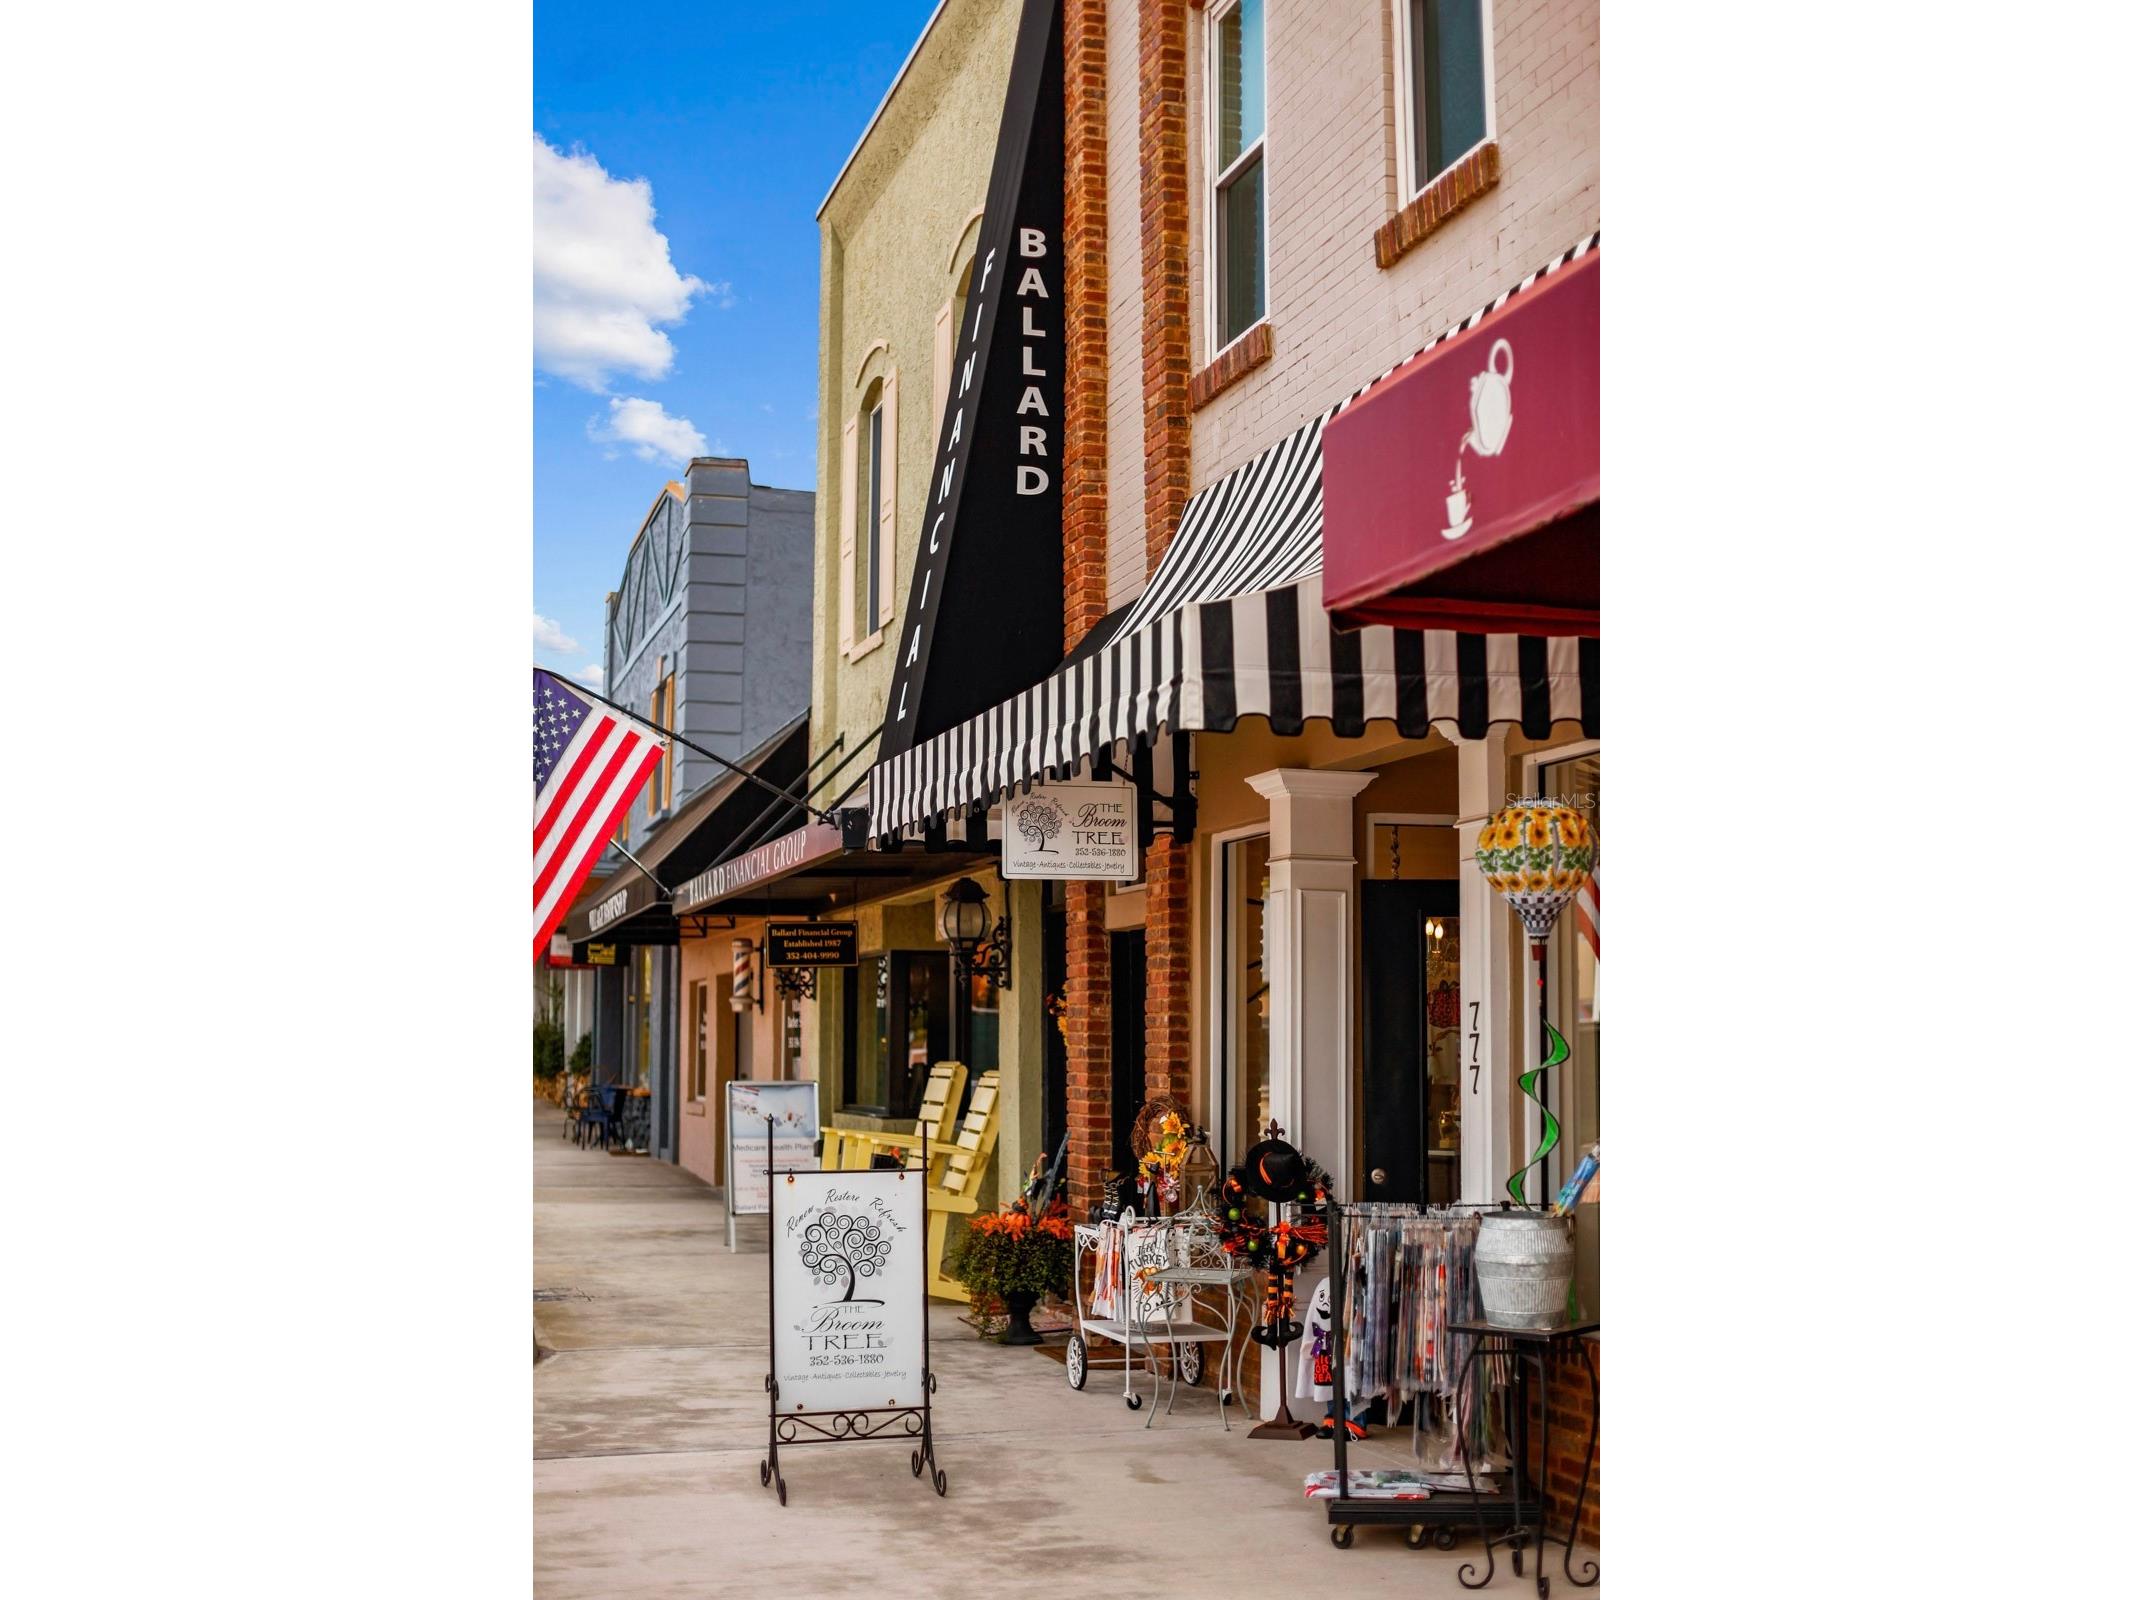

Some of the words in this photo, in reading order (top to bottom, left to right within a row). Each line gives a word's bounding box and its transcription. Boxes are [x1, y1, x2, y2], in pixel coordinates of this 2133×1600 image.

[1016, 228, 1049, 496] BALLARD
[897, 248, 996, 722] FINANCIAL
[1072, 803, 1127, 828] Broom
[1101, 803, 1125, 813] THE
[1071, 831, 1126, 846] TREE
[1075, 847, 1126, 857] 352-536-1880
[689, 868, 724, 905] BALLARD
[726, 848, 770, 889] FINANCIAL
[773, 830, 806, 870] GROUP
[1013, 860, 1036, 870] Vintage
[1039, 860, 1066, 870] Antiques
[771, 929, 796, 937] Ballard
[798, 929, 829, 937] Financial
[830, 929, 853, 938] Group
[783, 939, 823, 948] Established
[824, 939, 841, 947] 1987
[785, 951, 840, 960] 352-404-9990
[1469, 1001, 1480, 1095] 777
[786, 1205, 815, 1238] Renew
[825, 1188, 861, 1204] Restore
[869, 1197, 908, 1233] Refresh
[1129, 1253, 1169, 1270] TURKEY
[842, 1305, 865, 1314] THE
[801, 1306, 885, 1333] Broom
[801, 1333, 887, 1351] TREE
[809, 1354, 884, 1367] 352-536-1880
[784, 1373, 809, 1383] Vintage
[812, 1372, 842, 1382] Antiques
